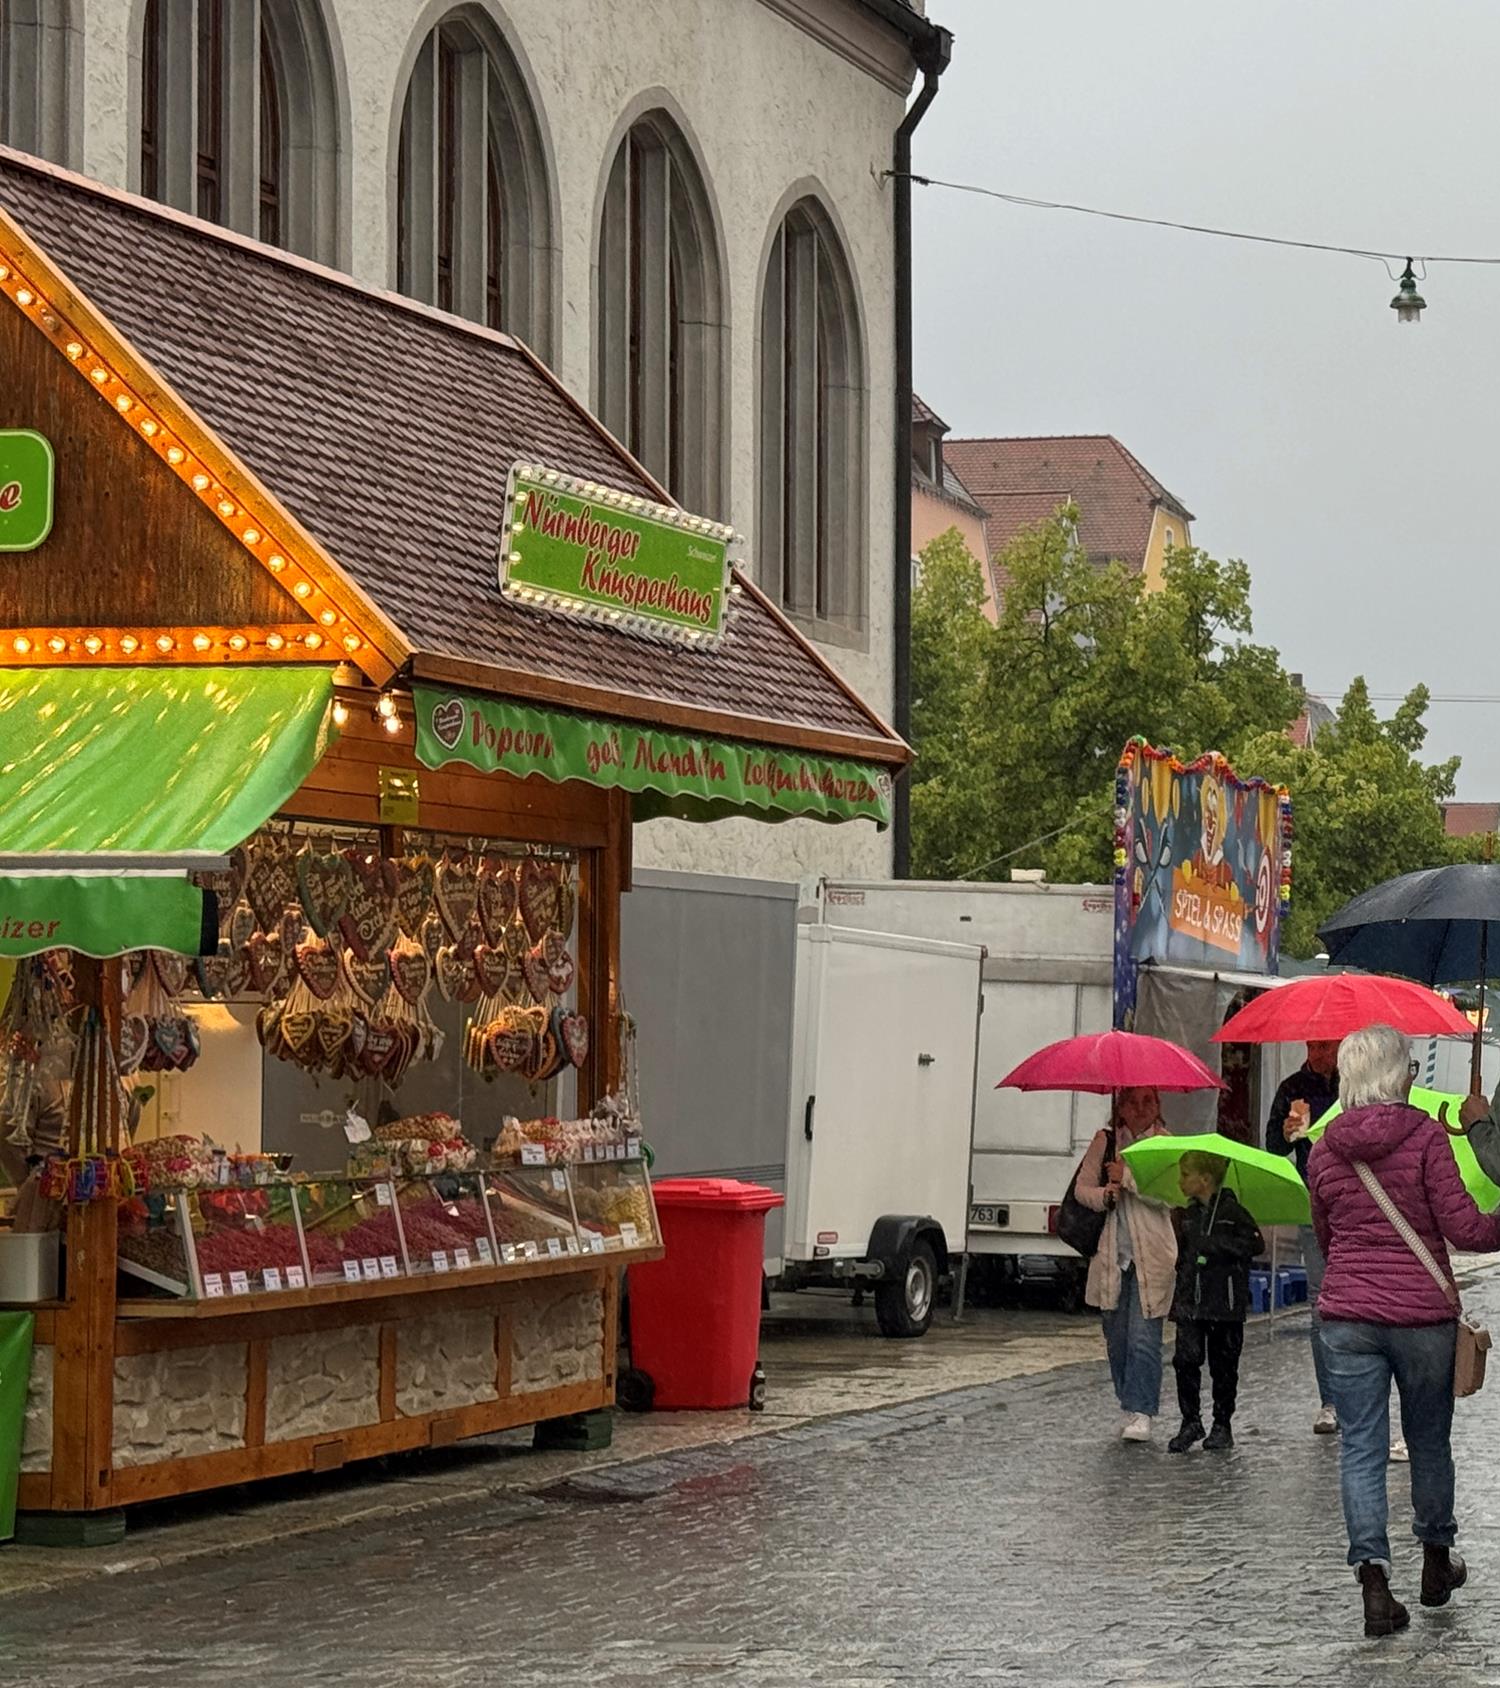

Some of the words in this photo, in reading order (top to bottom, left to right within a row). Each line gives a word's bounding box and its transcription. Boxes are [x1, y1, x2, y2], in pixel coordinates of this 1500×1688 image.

[522, 489, 641, 567] Nürnberger
[579, 550, 713, 625] Knusperhaus
[470, 710, 555, 761] Popcorn
[0, 916, 61, 939] izer
[1175, 889, 1202, 928] SPIEL
[1211, 905, 1242, 942] SPASS
[970, 1208, 994, 1222] 763
